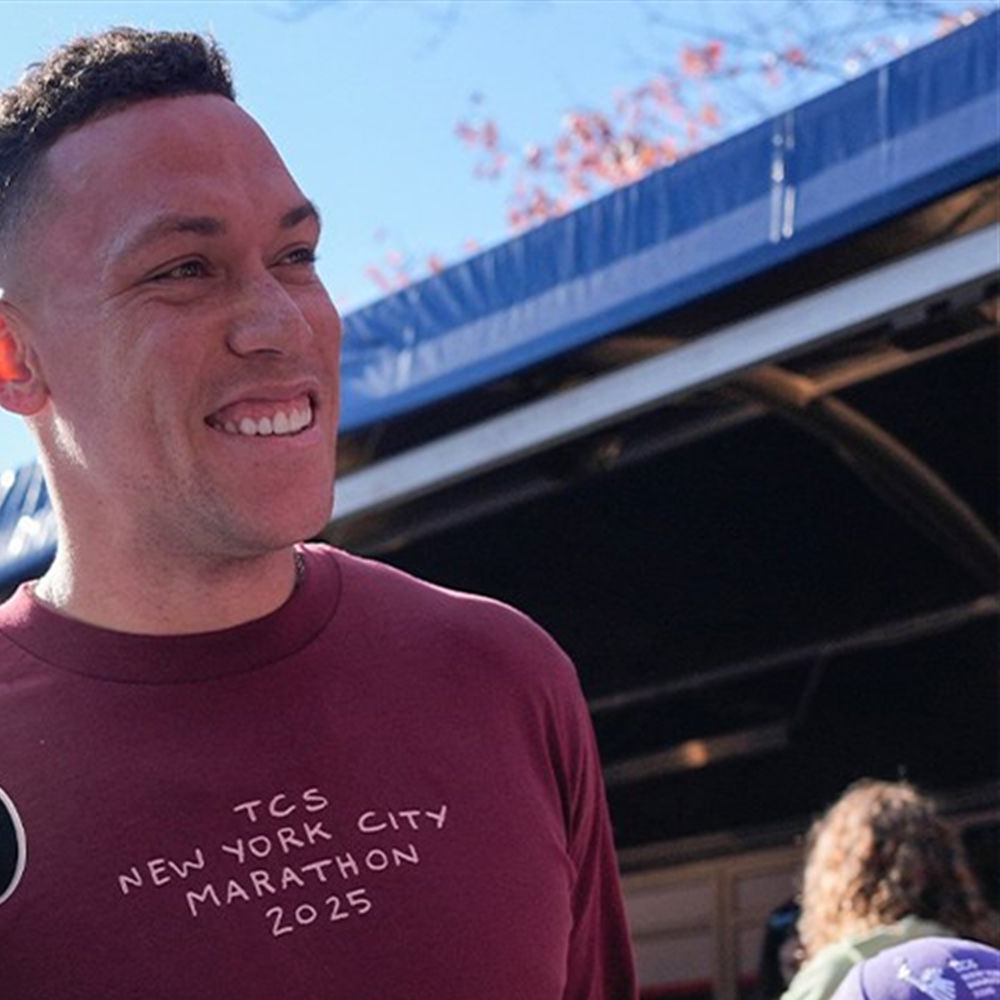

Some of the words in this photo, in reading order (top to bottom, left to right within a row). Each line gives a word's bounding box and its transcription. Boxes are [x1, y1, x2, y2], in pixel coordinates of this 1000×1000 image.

[233, 788, 329, 822] TCS
[118, 849, 205, 894] NEW
[222, 822, 332, 863] YORK
[358, 805, 447, 832] CITY
[186, 844, 419, 916] MARATHON
[265, 889, 371, 936] 2025
